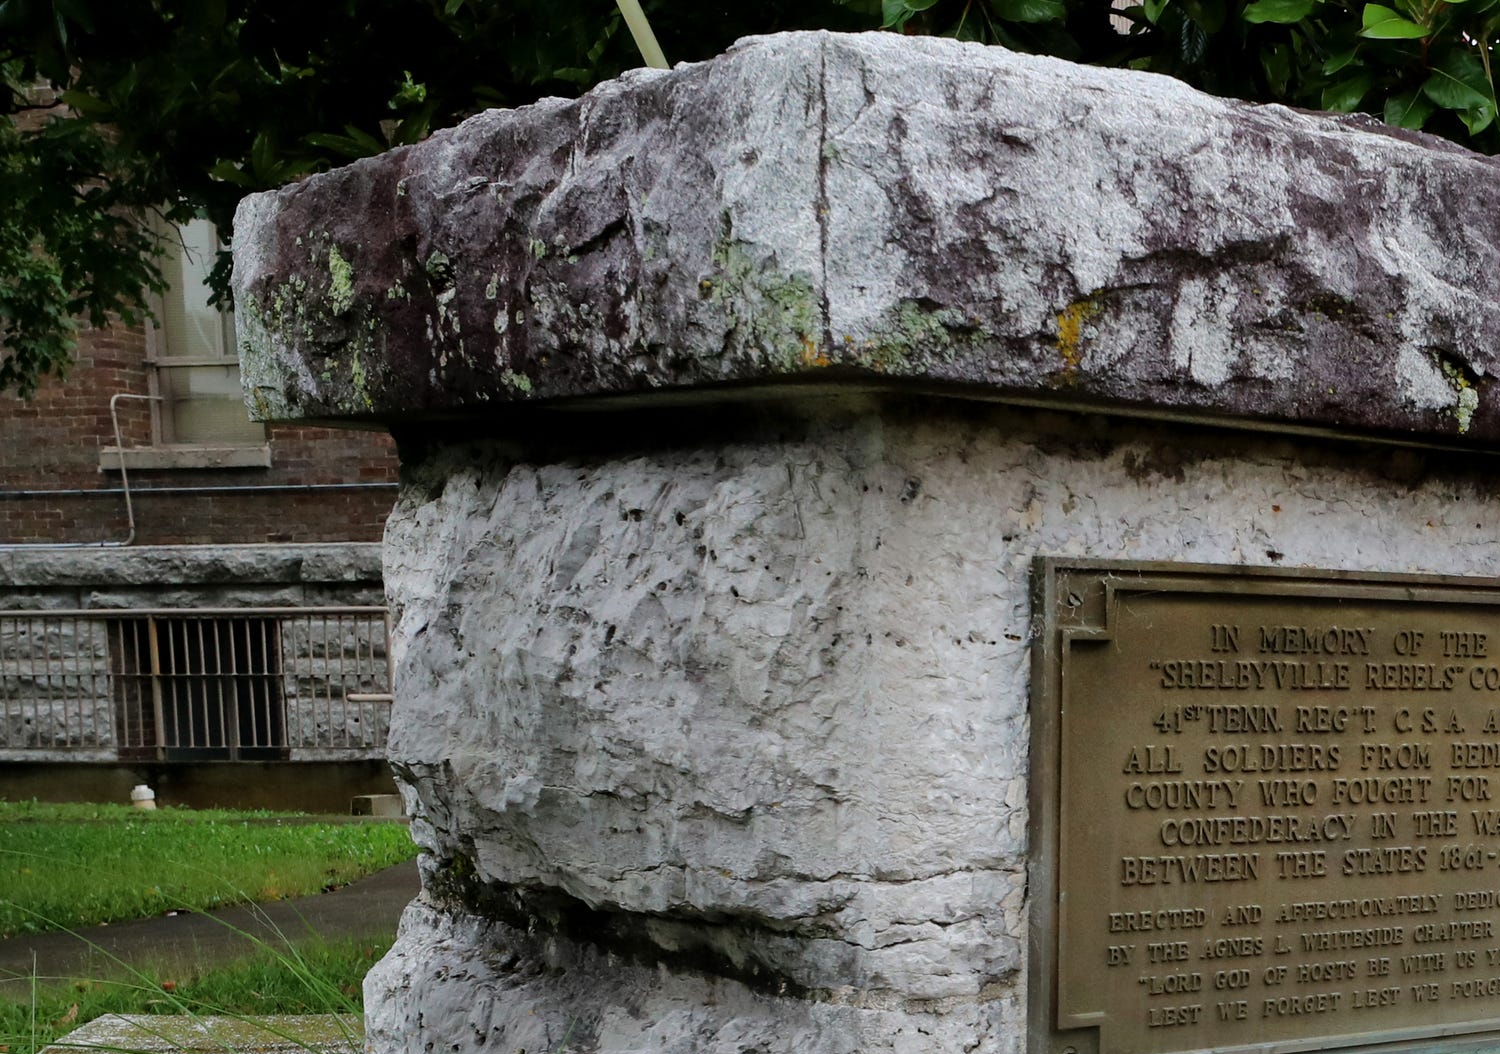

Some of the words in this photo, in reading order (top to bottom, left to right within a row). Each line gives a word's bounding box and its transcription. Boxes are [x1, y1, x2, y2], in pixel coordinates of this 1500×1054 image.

[1211, 624, 1240, 652] IN
[1259, 625, 1375, 655] MEMORY
[1394, 630, 1424, 657] OF
[1440, 631, 1488, 658] THE
[1206, 704, 1283, 734] TENN.
[1123, 745, 1183, 775] ALL
[1203, 743, 1341, 773] SOLDIERS
[1361, 742, 1432, 770] FROM
[1125, 779, 1244, 810] COUNTY
[1258, 778, 1318, 807] WHO
[1332, 776, 1432, 805] FOUGHT
[1446, 775, 1492, 802] FOR
[1160, 814, 1357, 847] CONFEDERACY
[1371, 811, 1398, 840] IN
[1412, 810, 1458, 838] THE
[1121, 852, 1261, 886] BETWEEN
[1276, 850, 1328, 879] THE
[1342, 846, 1428, 876] STATES
[1109, 908, 1207, 933] ERECTED
[1221, 904, 1263, 926] AND
[1275, 894, 1443, 924] AFFECTIONATELY
[1107, 945, 1136, 966] BY
[1148, 941, 1190, 964] THE
[1199, 937, 1264, 960] AGNES
[1274, 935, 1292, 955] L.
[1301, 927, 1404, 952] WHITESIDE
[1414, 919, 1494, 943] CHAPTER
[1215, 969, 1251, 990] GOD
[1263, 966, 1288, 986] OF
[1297, 960, 1357, 984] HOSTS
[1367, 957, 1390, 978] BE
[1400, 953, 1446, 975] WITH
[1455, 950, 1476, 969] US
[1148, 1004, 1202, 1028] LEST
[1216, 1000, 1249, 1022] WE
[1262, 993, 1342, 1019] FORGET
[1352, 986, 1401, 1009] LEST
[1412, 983, 1440, 1003] WE
